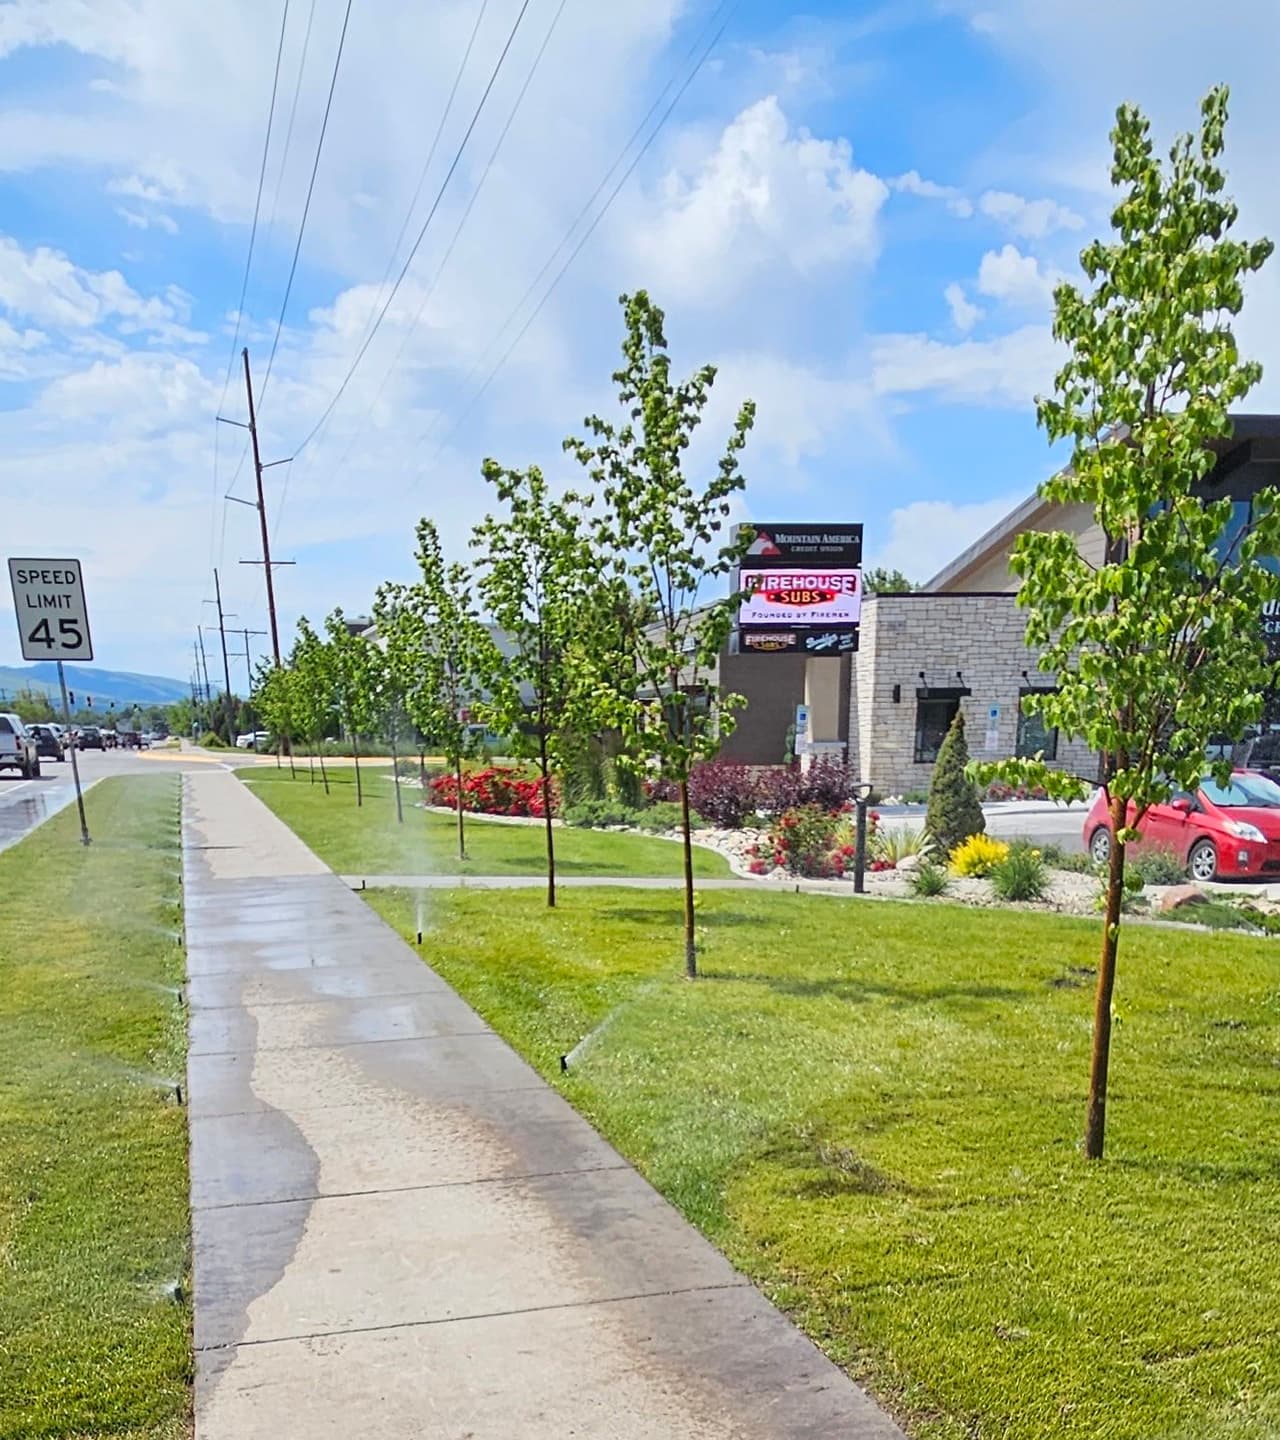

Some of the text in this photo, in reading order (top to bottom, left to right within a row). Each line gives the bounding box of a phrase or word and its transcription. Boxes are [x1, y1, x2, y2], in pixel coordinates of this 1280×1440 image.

[775, 533, 860, 543] MOUNTAIN AMERICA
[16, 569, 76, 585] SPEED
[26, 593, 72, 609] LIMIT
[780, 590, 821, 603] SUBS
[28, 617, 83, 650] 45
